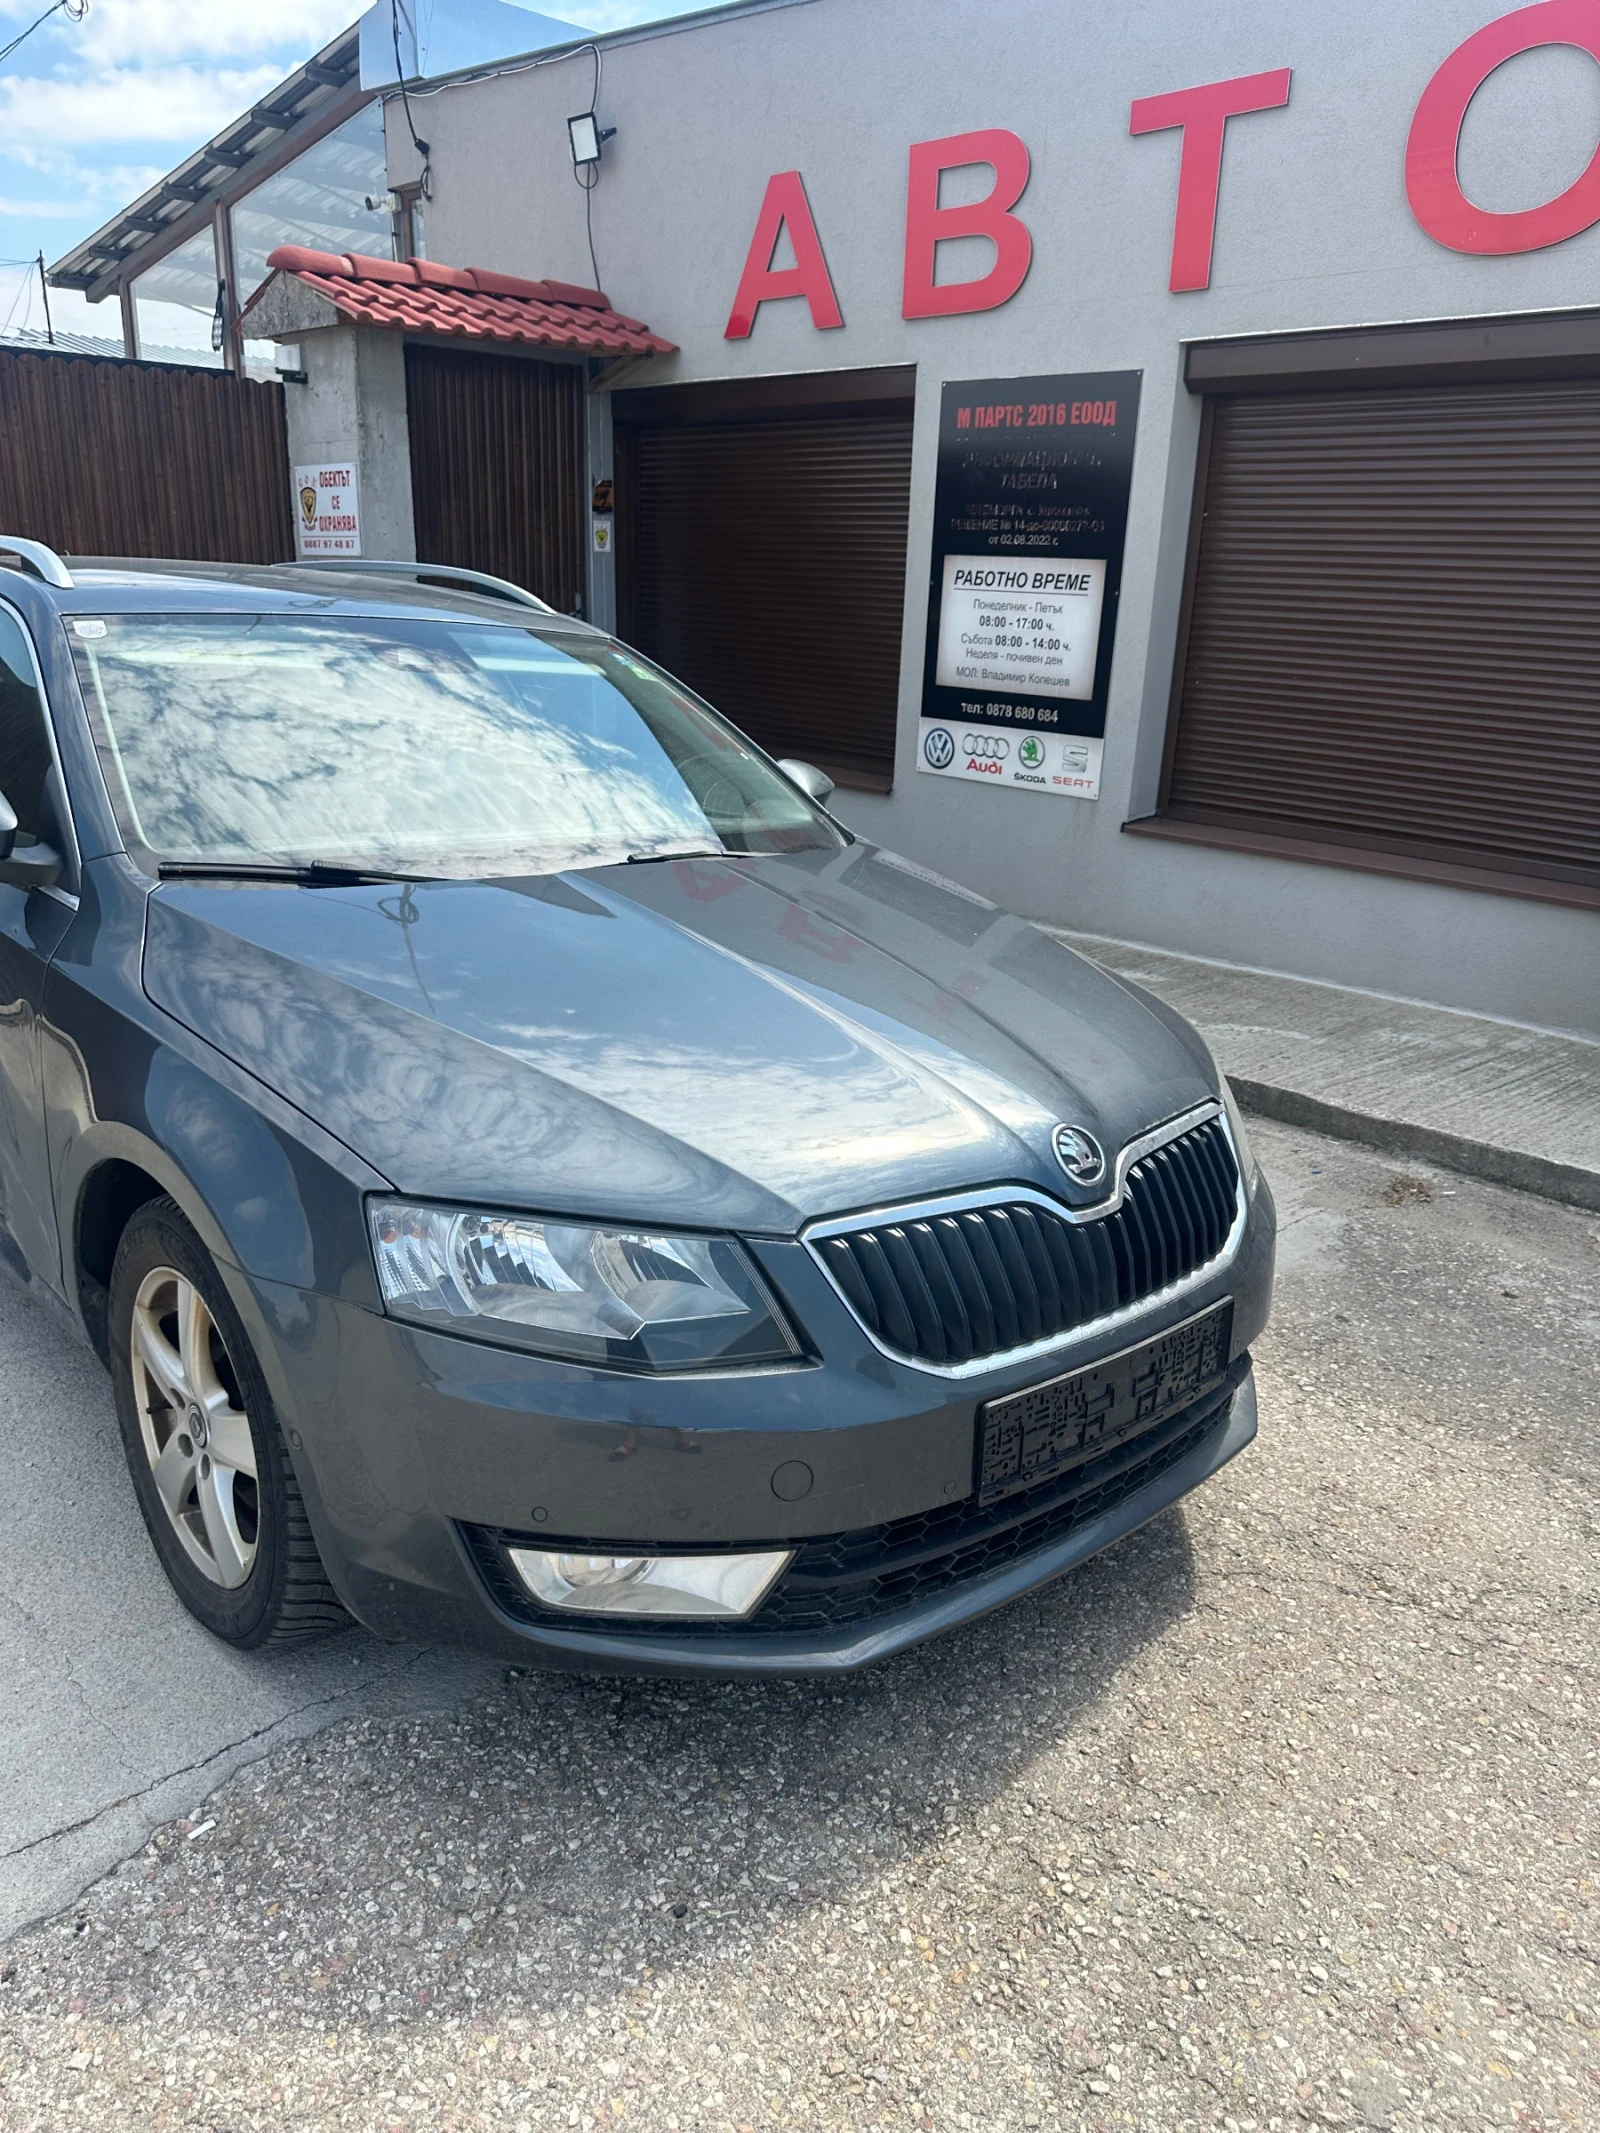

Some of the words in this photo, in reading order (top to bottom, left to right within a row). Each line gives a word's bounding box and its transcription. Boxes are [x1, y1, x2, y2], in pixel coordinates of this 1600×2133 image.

[956, 406, 971, 429] М
[974, 404, 1024, 429] ПАРТС
[1027, 402, 1067, 427] 2016
[1070, 400, 1117, 427] ЕООД
[319, 470, 350, 488] ОБЕКТЪТ
[331, 495, 341, 510] СЕ
[319, 515, 357, 532] ОХРАНЯВА
[1000, 534, 1051, 546] 02.08.2022
[954, 569, 1028, 589] РАБОТНО
[1031, 572, 1091, 591] ВРЕМЕ
[973, 598, 1028, 613] Понеделник
[1034, 602, 1064, 614] Петък
[979, 615, 1007, 628] 08:00
[1016, 617, 1044, 631] 17:00
[960, 633, 993, 646] Събота
[995, 635, 1023, 648] 08:00
[1032, 637, 1061, 650] 14:00
[966, 648, 998, 661] Неделя
[1006, 652, 1043, 665] почивен
[1045, 655, 1063, 666] ден
[956, 666, 979, 679] МОЛ:
[981, 668, 1027, 685] Владимир
[961, 702, 984, 715] тел:
[986, 703, 1012, 718] 0878
[1014, 705, 1035, 720] 680
[1037, 708, 1059, 723] 684
[966, 758, 1003, 775] Audi
[1014, 772, 1046, 785] ŠKODA
[1052, 775, 1094, 789] SEAT
